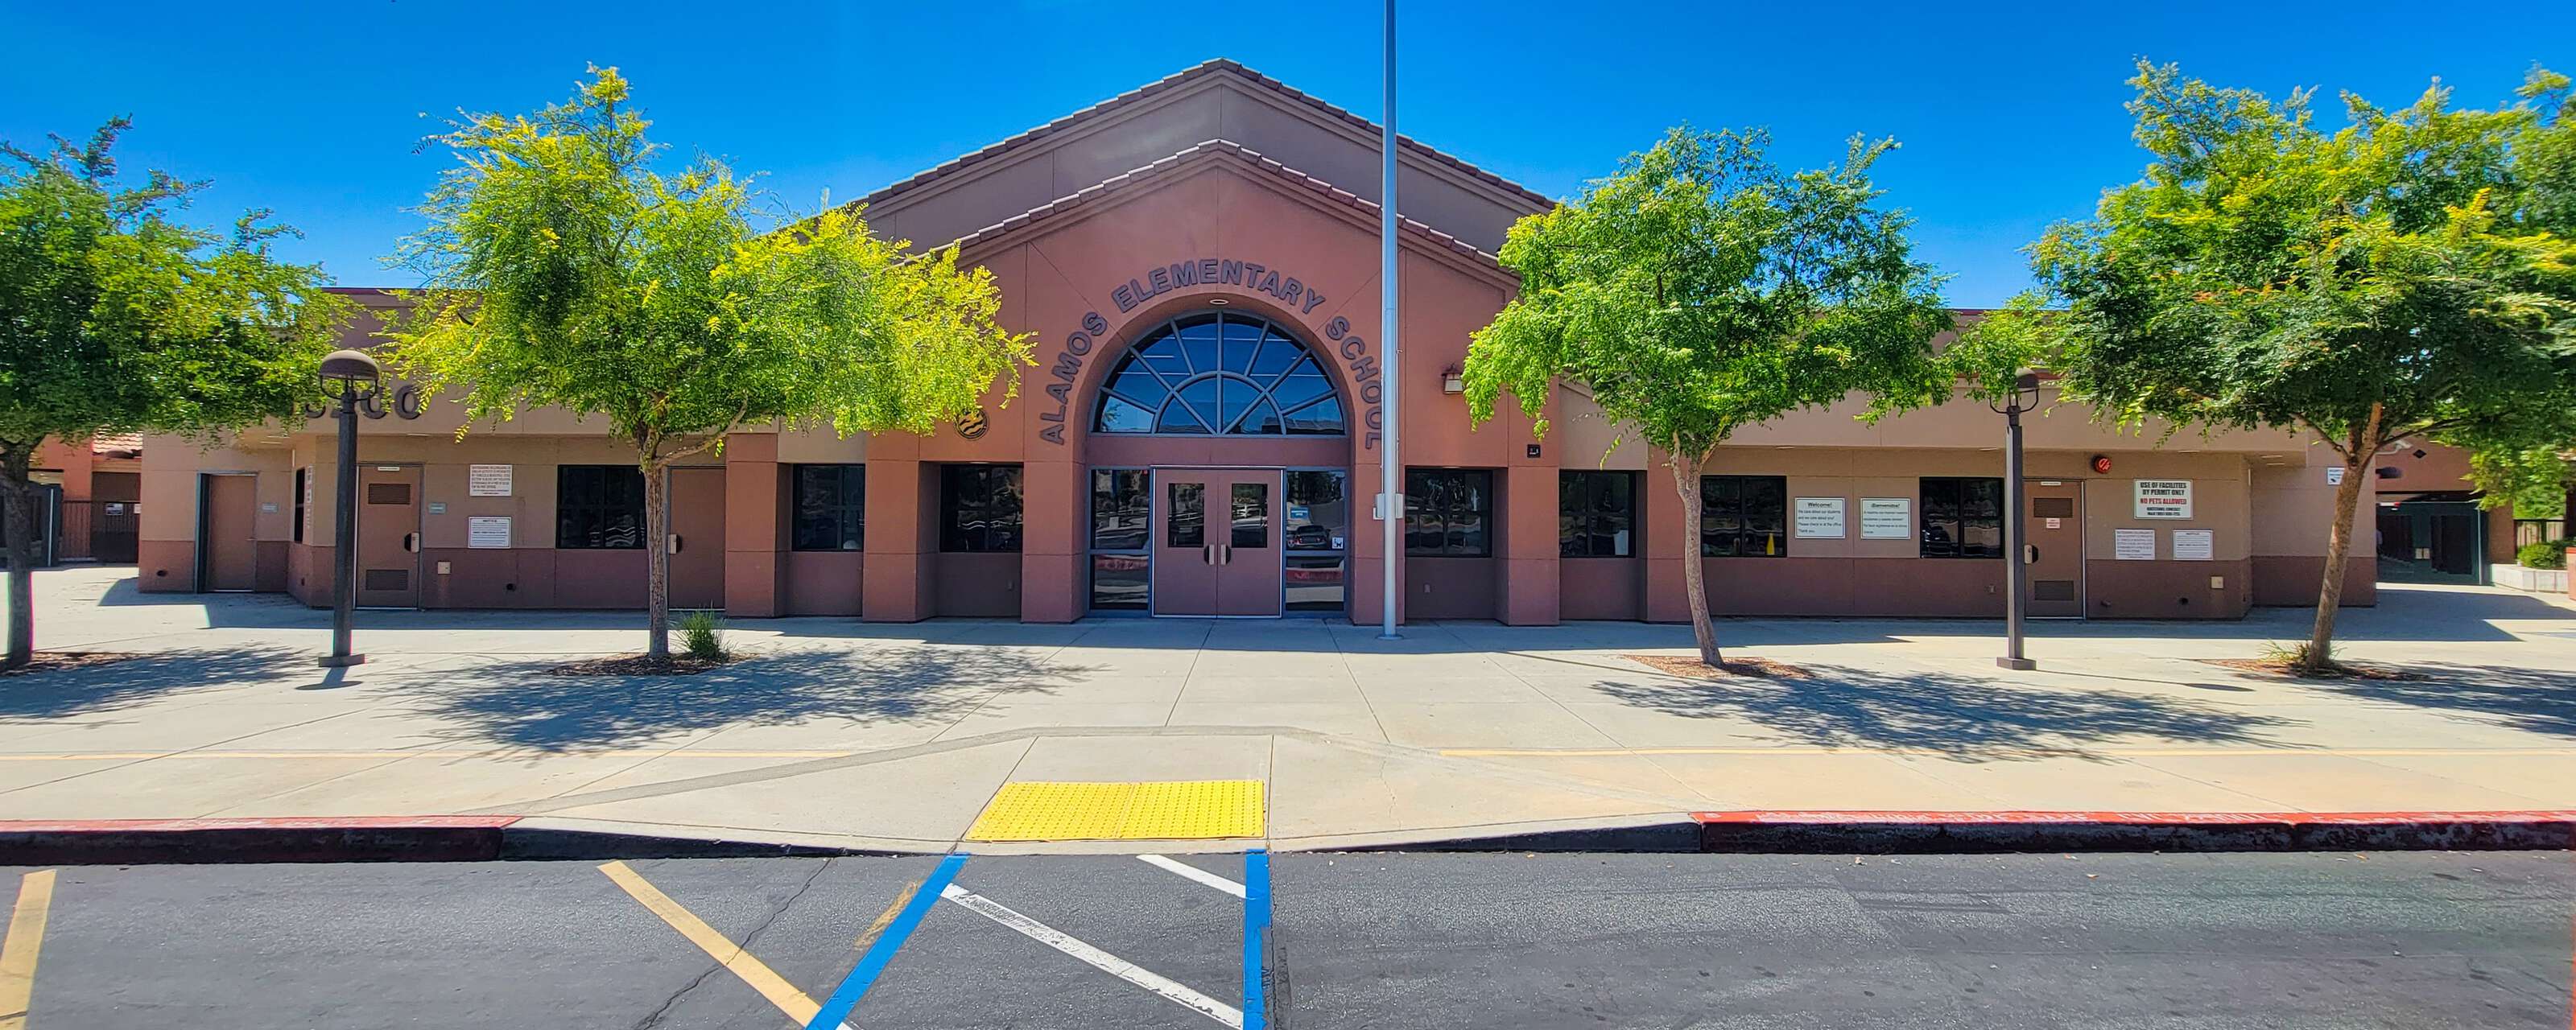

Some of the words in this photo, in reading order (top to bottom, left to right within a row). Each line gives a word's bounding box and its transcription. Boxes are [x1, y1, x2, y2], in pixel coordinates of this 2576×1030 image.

[1039, 311, 1108, 445] ALAMOS
[1111, 258, 1326, 315] ELEMENTARY
[1325, 315, 1383, 450] SCHOOL
